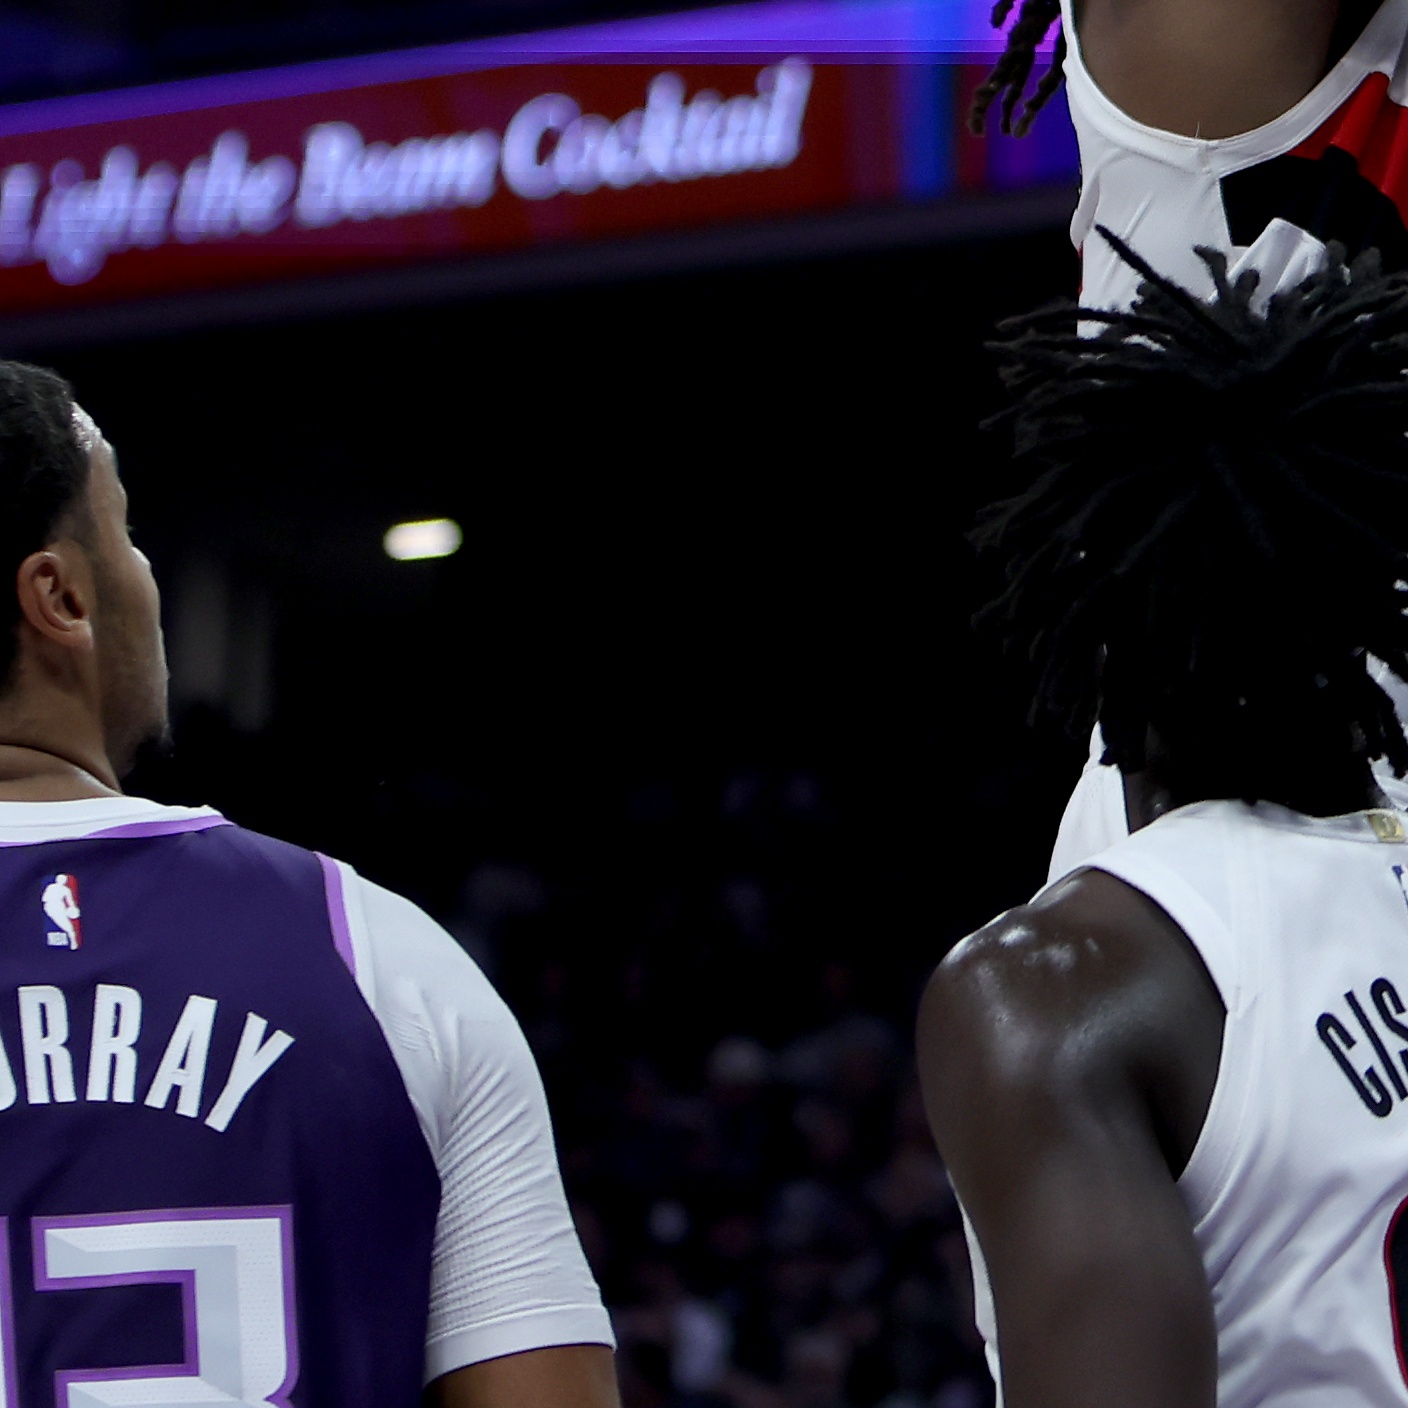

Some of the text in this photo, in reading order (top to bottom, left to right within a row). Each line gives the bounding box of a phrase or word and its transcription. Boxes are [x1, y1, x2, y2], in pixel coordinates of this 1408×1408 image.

[173, 128, 298, 245] the
[296, 121, 500, 230] Beam
[502, 55, 812, 200] Cocktail
